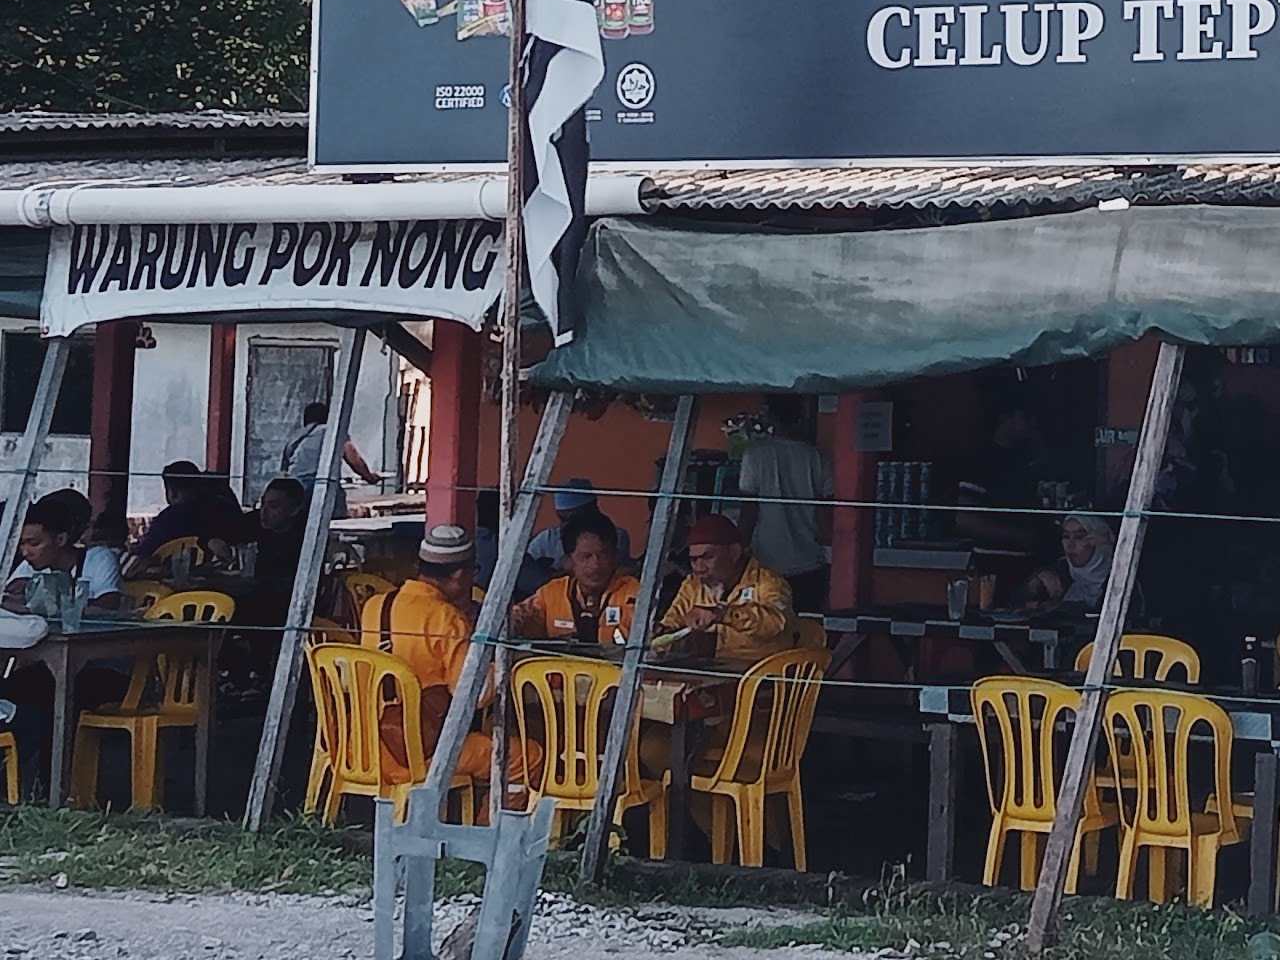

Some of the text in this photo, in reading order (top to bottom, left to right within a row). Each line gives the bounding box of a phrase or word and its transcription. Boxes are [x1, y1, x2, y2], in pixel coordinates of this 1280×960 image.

[866, 2, 1105, 70] CELUP
[435, 85, 484, 98] ISO 22000
[435, 96, 484, 109] CERTIFIED
[67, 220, 499, 295] WARUNG POK NONG
